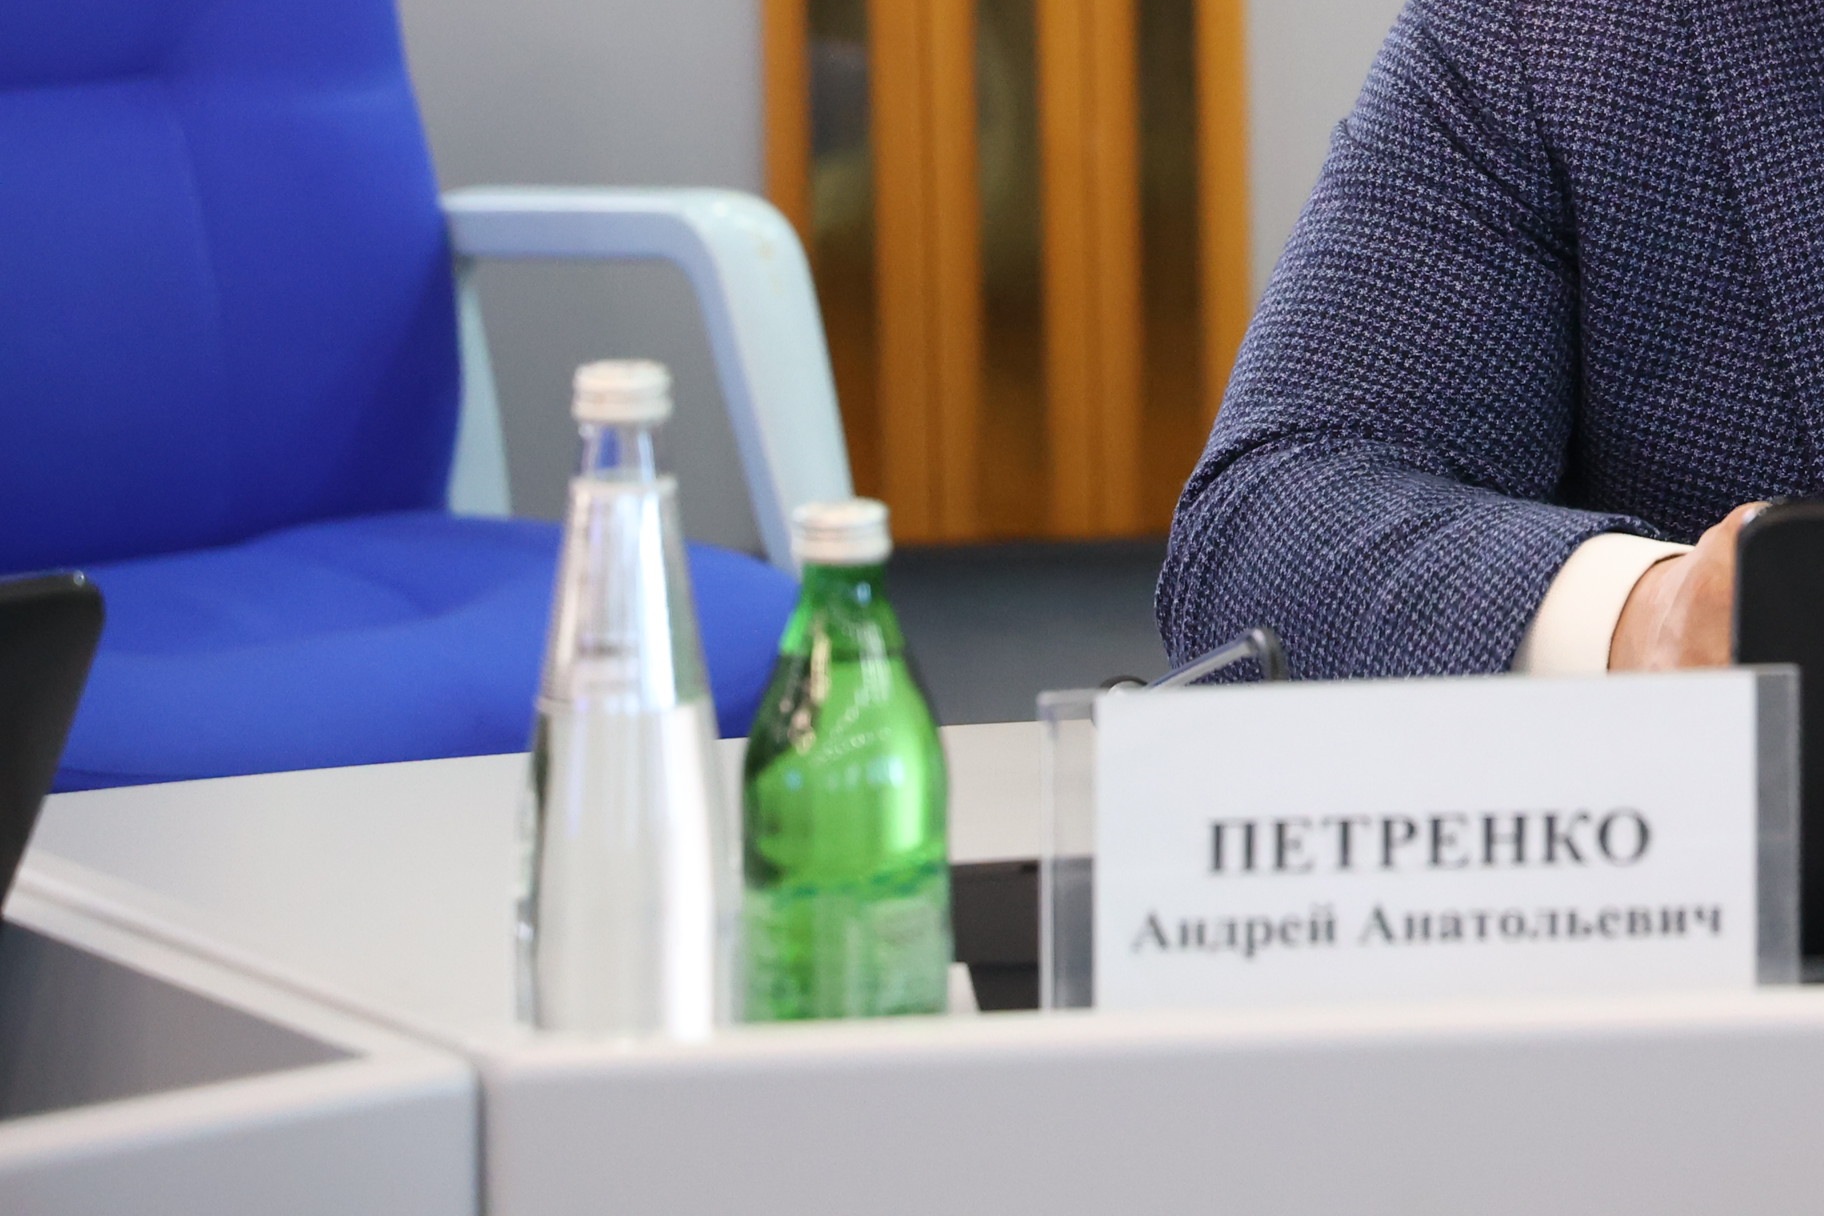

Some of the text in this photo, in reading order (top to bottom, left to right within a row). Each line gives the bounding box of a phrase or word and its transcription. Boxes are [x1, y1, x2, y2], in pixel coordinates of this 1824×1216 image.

[1208, 808, 1653, 876] ПЕТРЕНКО
[1133, 904, 1722, 960] Андрей Анатольевич
